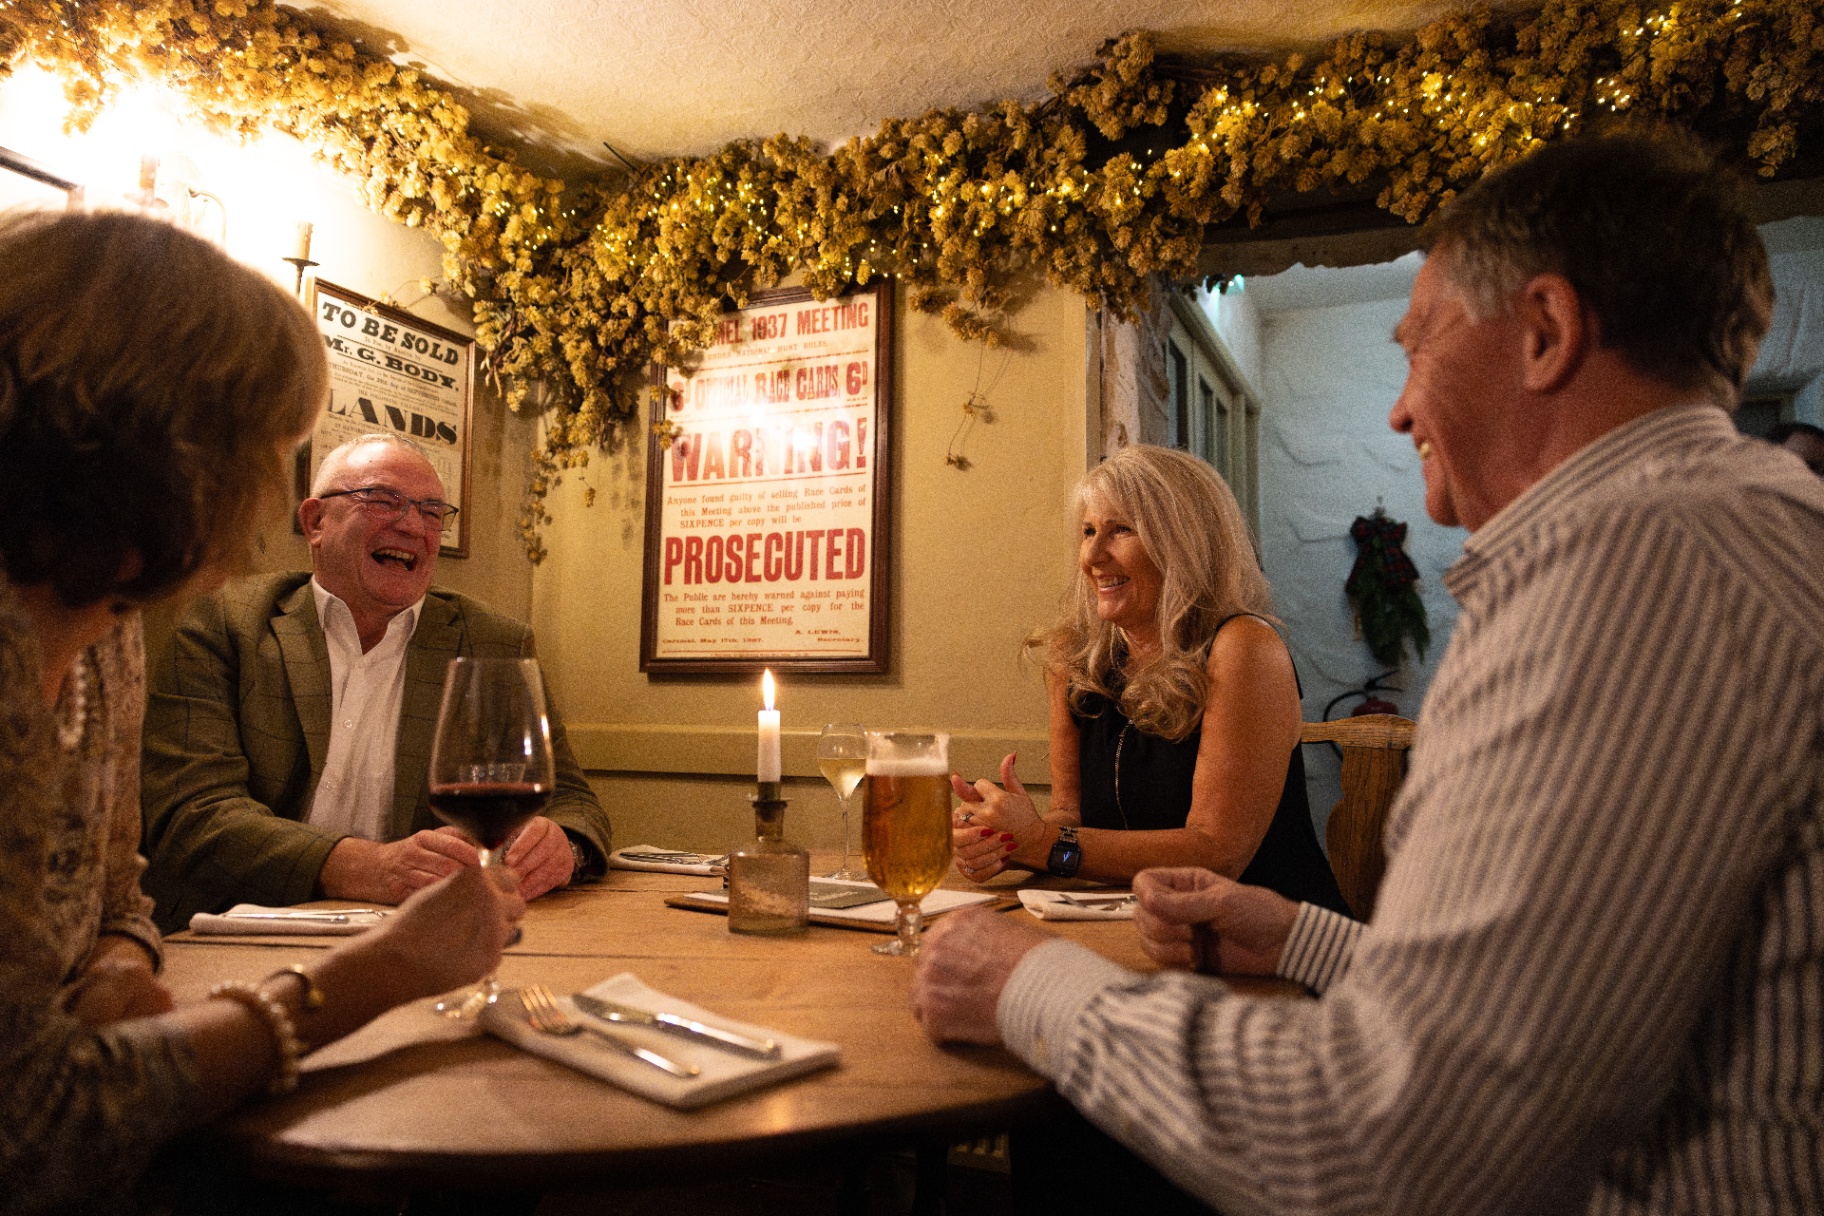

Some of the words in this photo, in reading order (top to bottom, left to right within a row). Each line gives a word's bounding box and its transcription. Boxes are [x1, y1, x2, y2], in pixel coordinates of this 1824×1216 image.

[751, 313, 788, 341] 1937
[797, 302, 869, 336] MEETING
[322, 302, 356, 328] TO
[361, 317, 398, 344] BE
[401, 332, 459, 366] SOLD
[357, 347, 381, 365] G.
[385, 355, 459, 391] BODY.
[328, 388, 457, 445] LANDS
[667, 495, 697, 506] Anyone
[702, 494, 725, 503] found
[730, 492, 753, 503] guilty
[757, 491, 766, 500] of
[771, 490, 798, 500] selling
[804, 487, 824, 497] Race
[829, 485, 853, 495] Cards
[858, 484, 867, 493] of
[680, 508, 696, 517] this
[702, 506, 732, 517] Meeting
[738, 505, 762, 514] above
[767, 503, 780, 513] the
[786, 501, 826, 513] published
[832, 499, 853, 509] price
[858, 497, 867, 507] of
[680, 518, 725, 529] SIXPENCE
[730, 518, 742, 528] per
[747, 517, 766, 527] copy
[771, 515, 788, 524] will
[793, 514, 802, 523] be
[664, 527, 866, 585] PROSECUTED
[664, 592, 679, 602] The
[684, 592, 708, 602] Public
[713, 593, 726, 601] are
[731, 591, 759, 602] hereby
[764, 590, 795, 600] warned
[800, 589, 831, 600] against
[836, 588, 865, 600] paying
[675, 606, 696, 614] more
[702, 604, 721, 614] than
[728, 603, 774, 613] SIXPENCE
[781, 604, 795, 613] per
[802, 603, 821, 613] copy
[830, 602, 843, 611] for
[851, 601, 865, 610] the
[675, 617, 695, 626] Race
[699, 616, 722, 626] Cards
[726, 616, 735, 625] of
[740, 616, 755, 625] this
